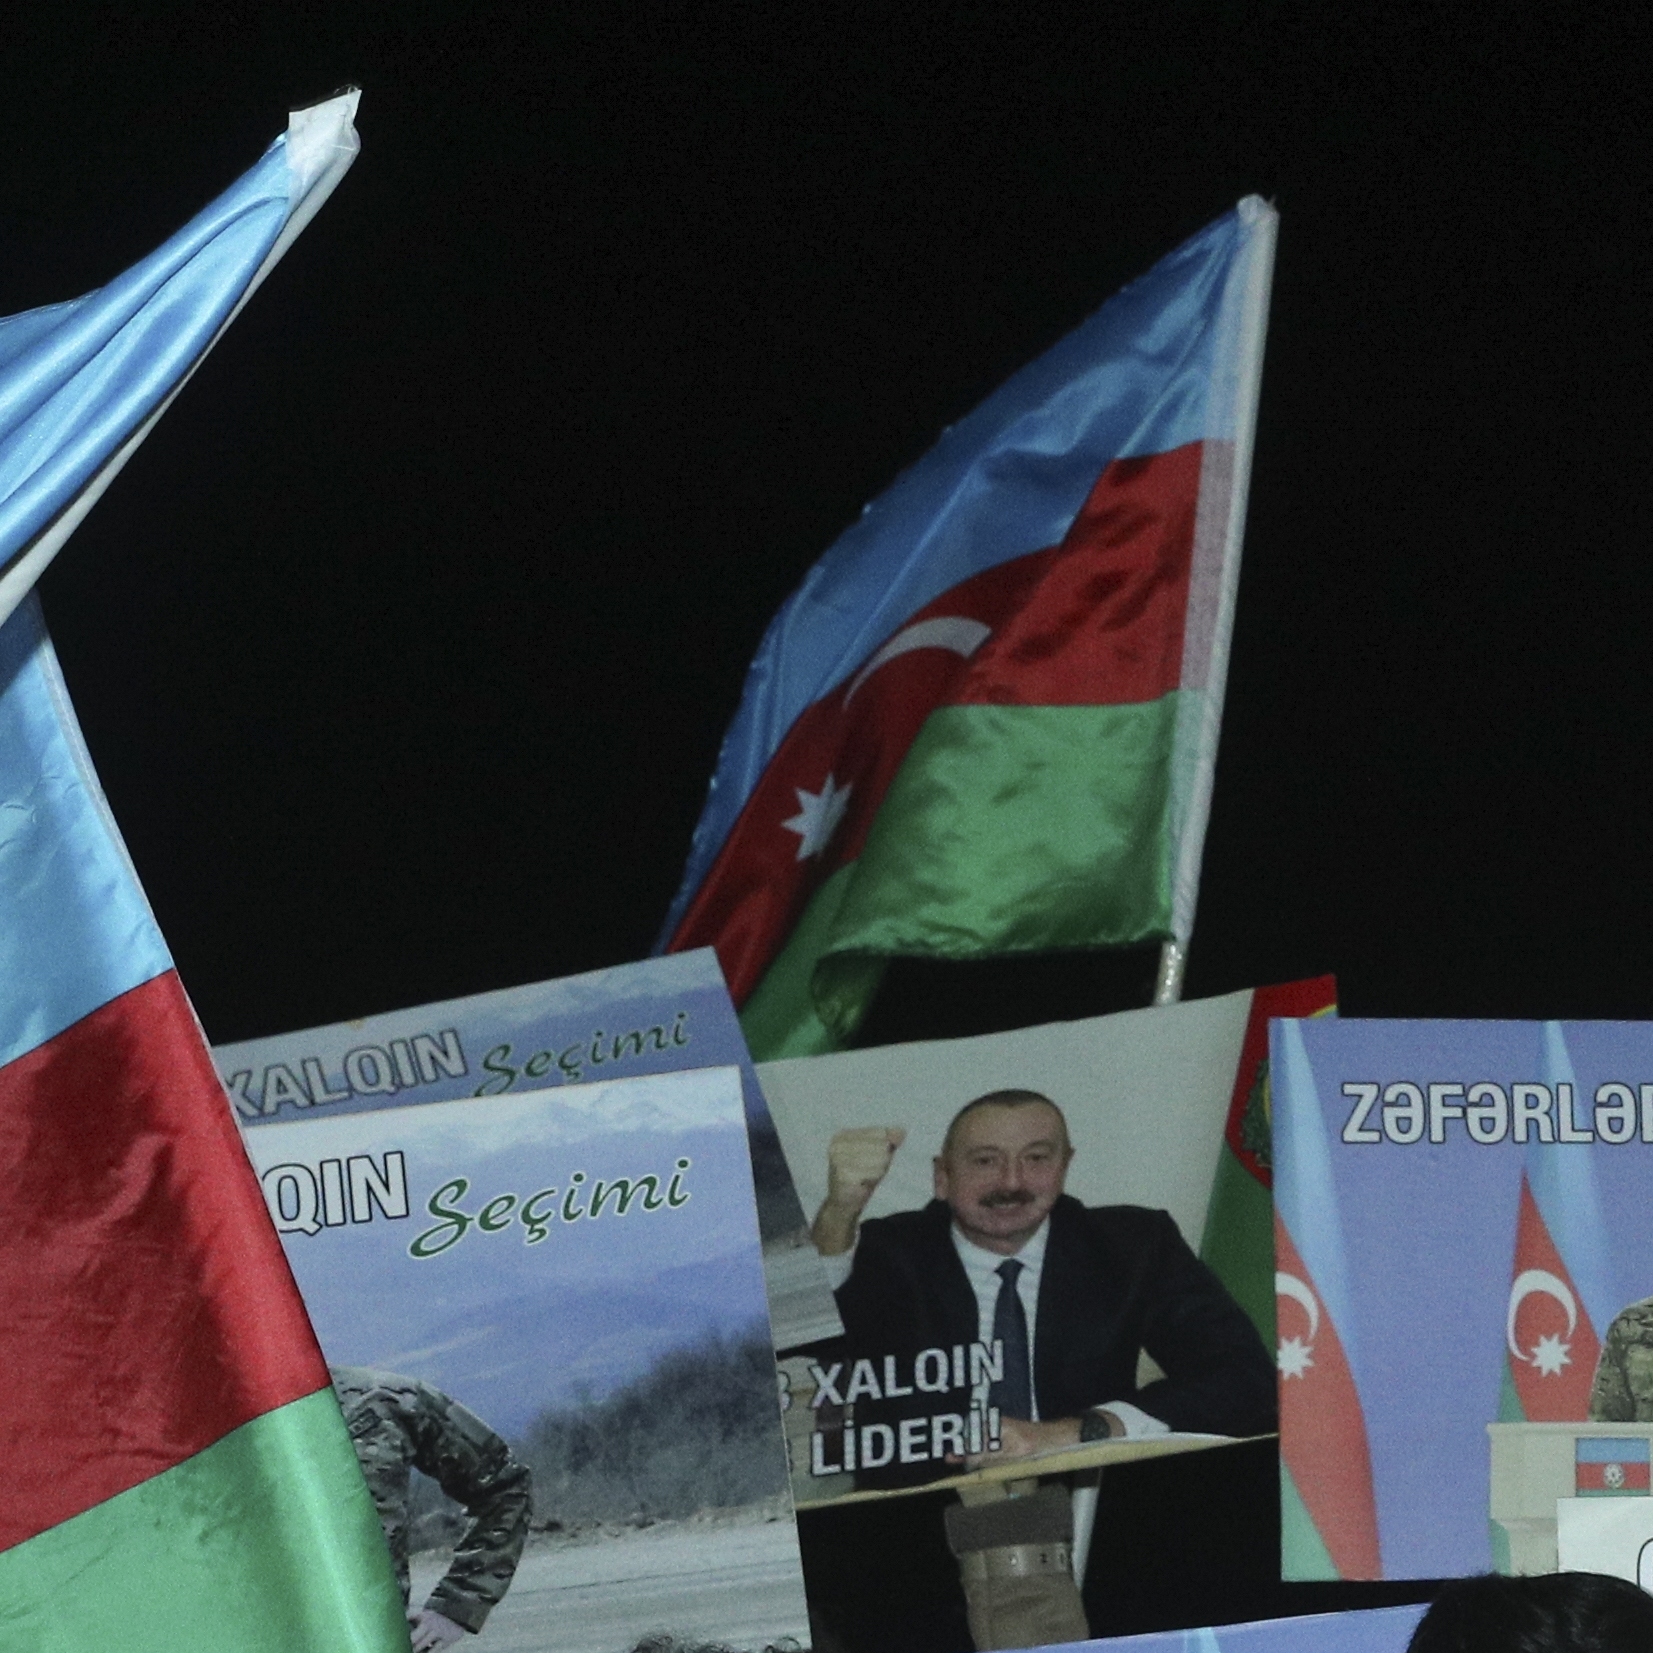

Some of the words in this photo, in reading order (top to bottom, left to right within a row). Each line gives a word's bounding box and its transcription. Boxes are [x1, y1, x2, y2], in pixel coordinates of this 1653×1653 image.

[474, 1011, 691, 1098] Seçimi
[406, 1157, 691, 1260] Seçimi
[810, 1338, 1005, 1408] XALQIN
[810, 1398, 1001, 1477] LİDERİ!
